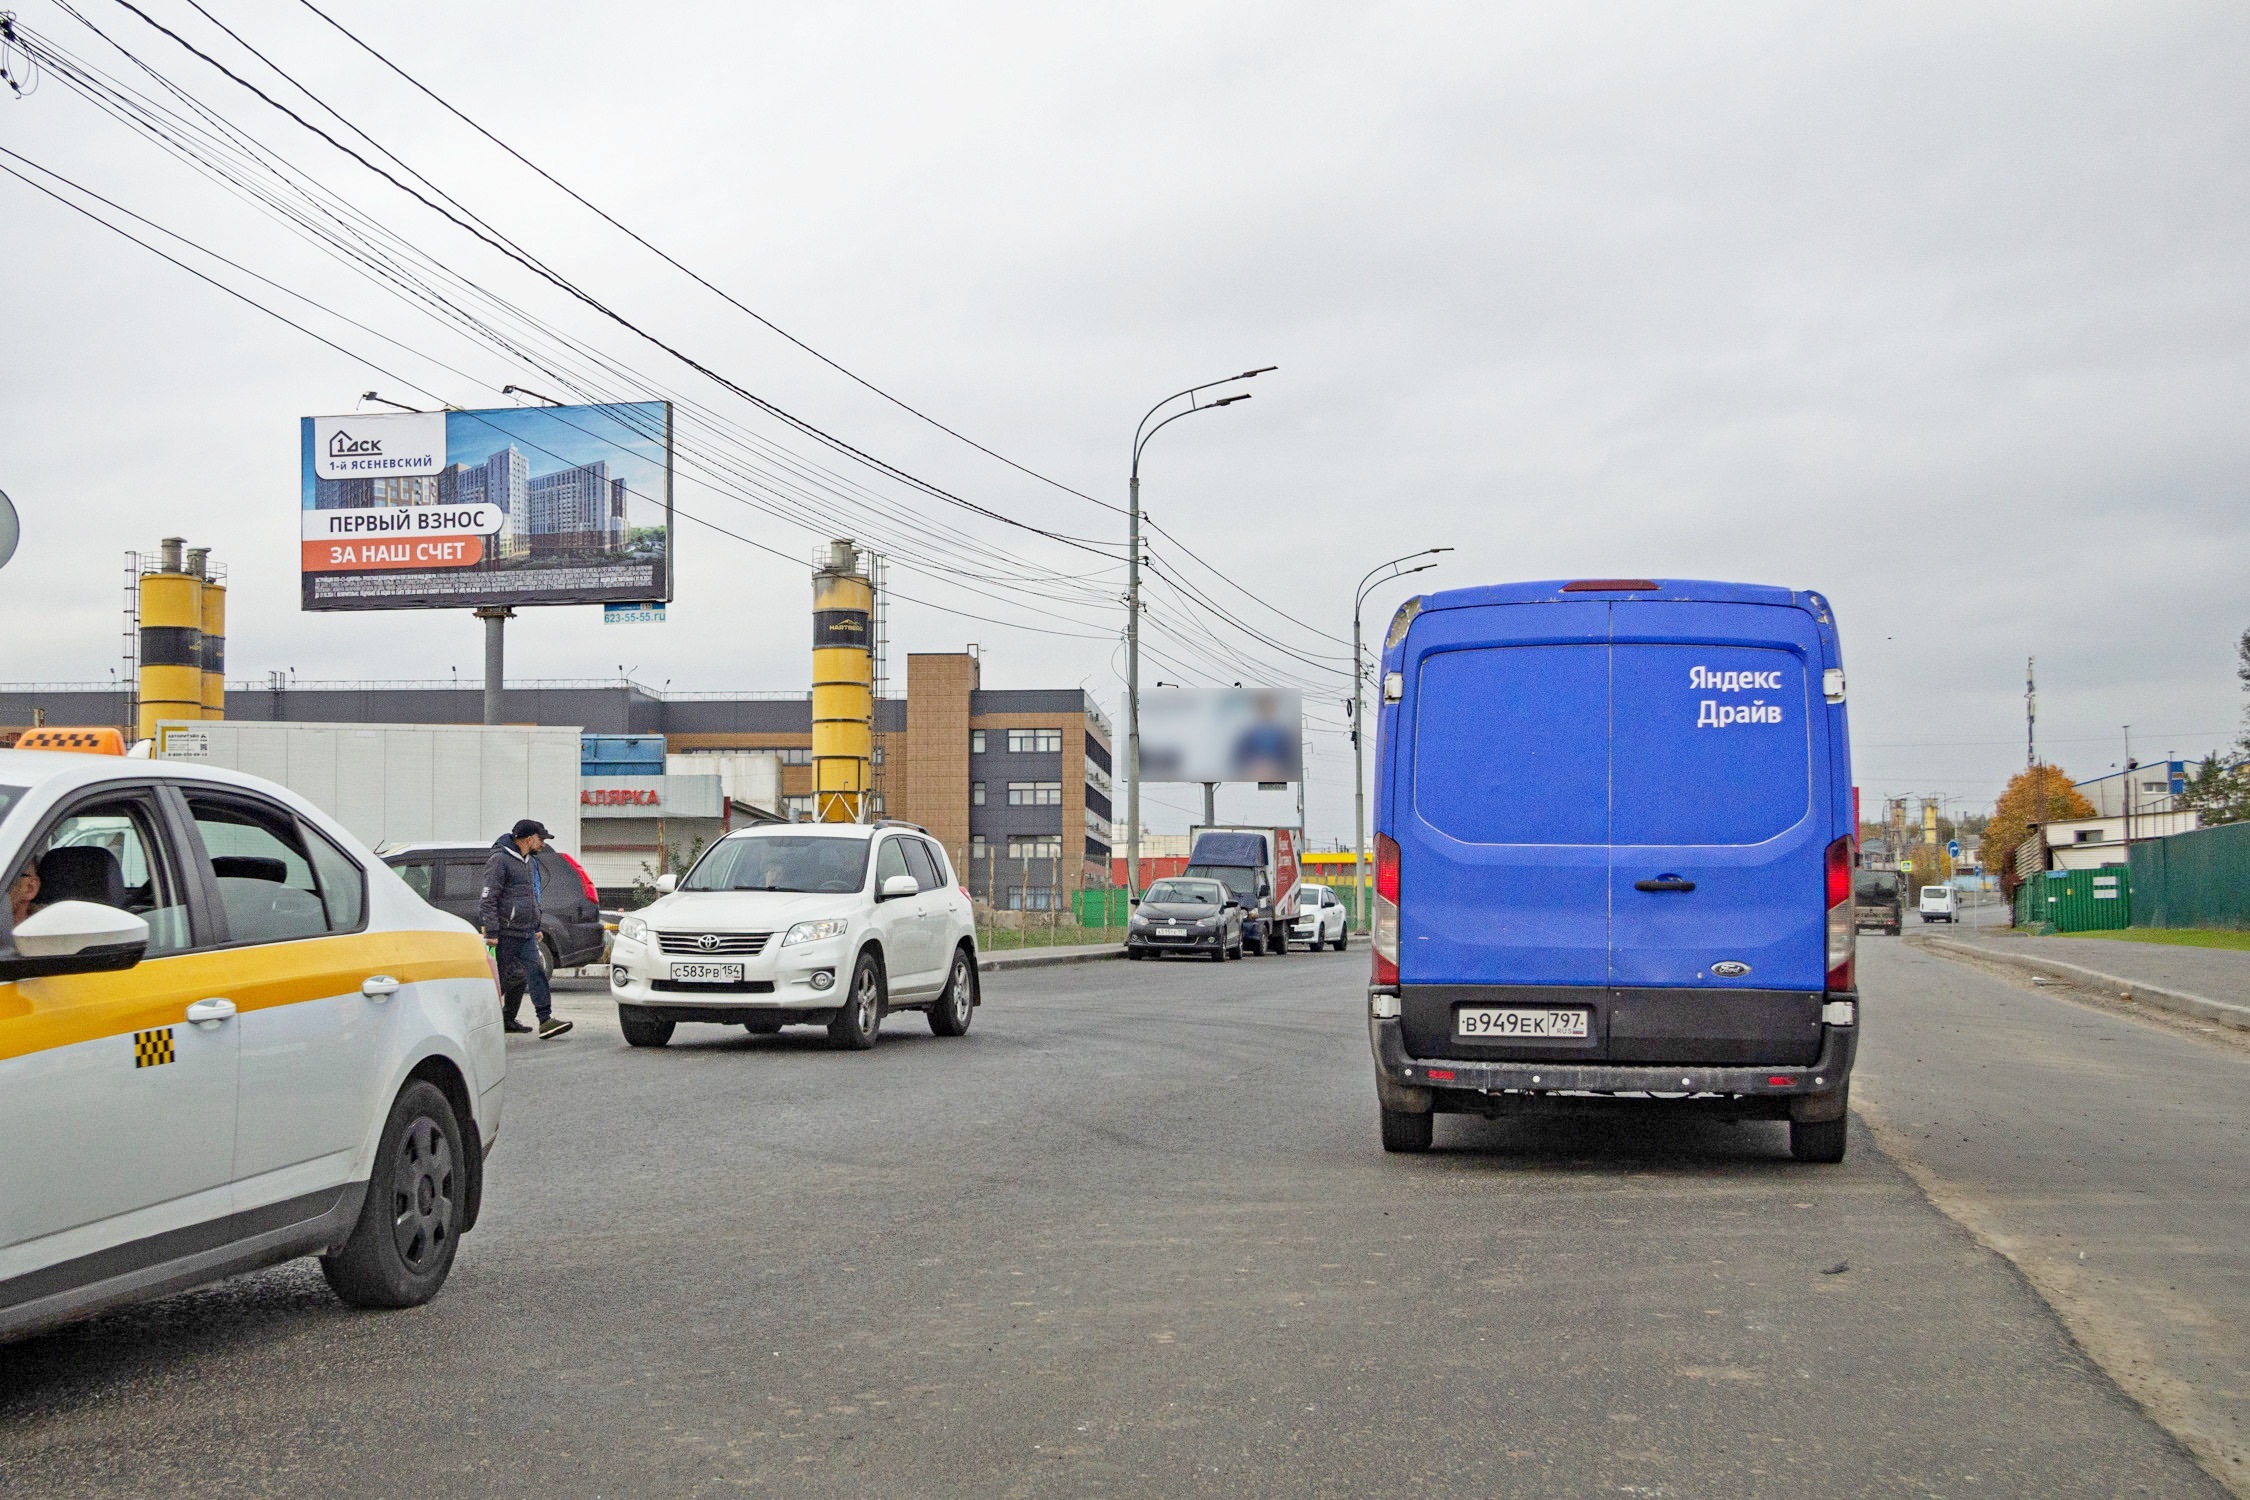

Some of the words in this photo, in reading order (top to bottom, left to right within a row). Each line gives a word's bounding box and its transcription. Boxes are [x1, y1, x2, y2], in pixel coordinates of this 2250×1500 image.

[329, 461, 347, 471] 1-й
[351, 455, 432, 470] ЯСЕНЕВСКИЙ
[329, 508, 411, 533] ПЕРВЫЙ
[417, 510, 485, 530] ВЗНОС
[329, 546, 357, 564] ЗА
[361, 543, 411, 563] НАШ
[416, 541, 466, 561] СЧЕТ
[604, 612, 666, 623] 623-55-55.ru
[1689, 665, 1782, 692] Яндекс
[1697, 700, 1782, 728] Драйв
[675, 965, 720, 978] С583РВ
[722, 965, 740, 975] 154
[1466, 1013, 1545, 1033] В949ЕК
[1550, 1013, 1581, 1028] 797
